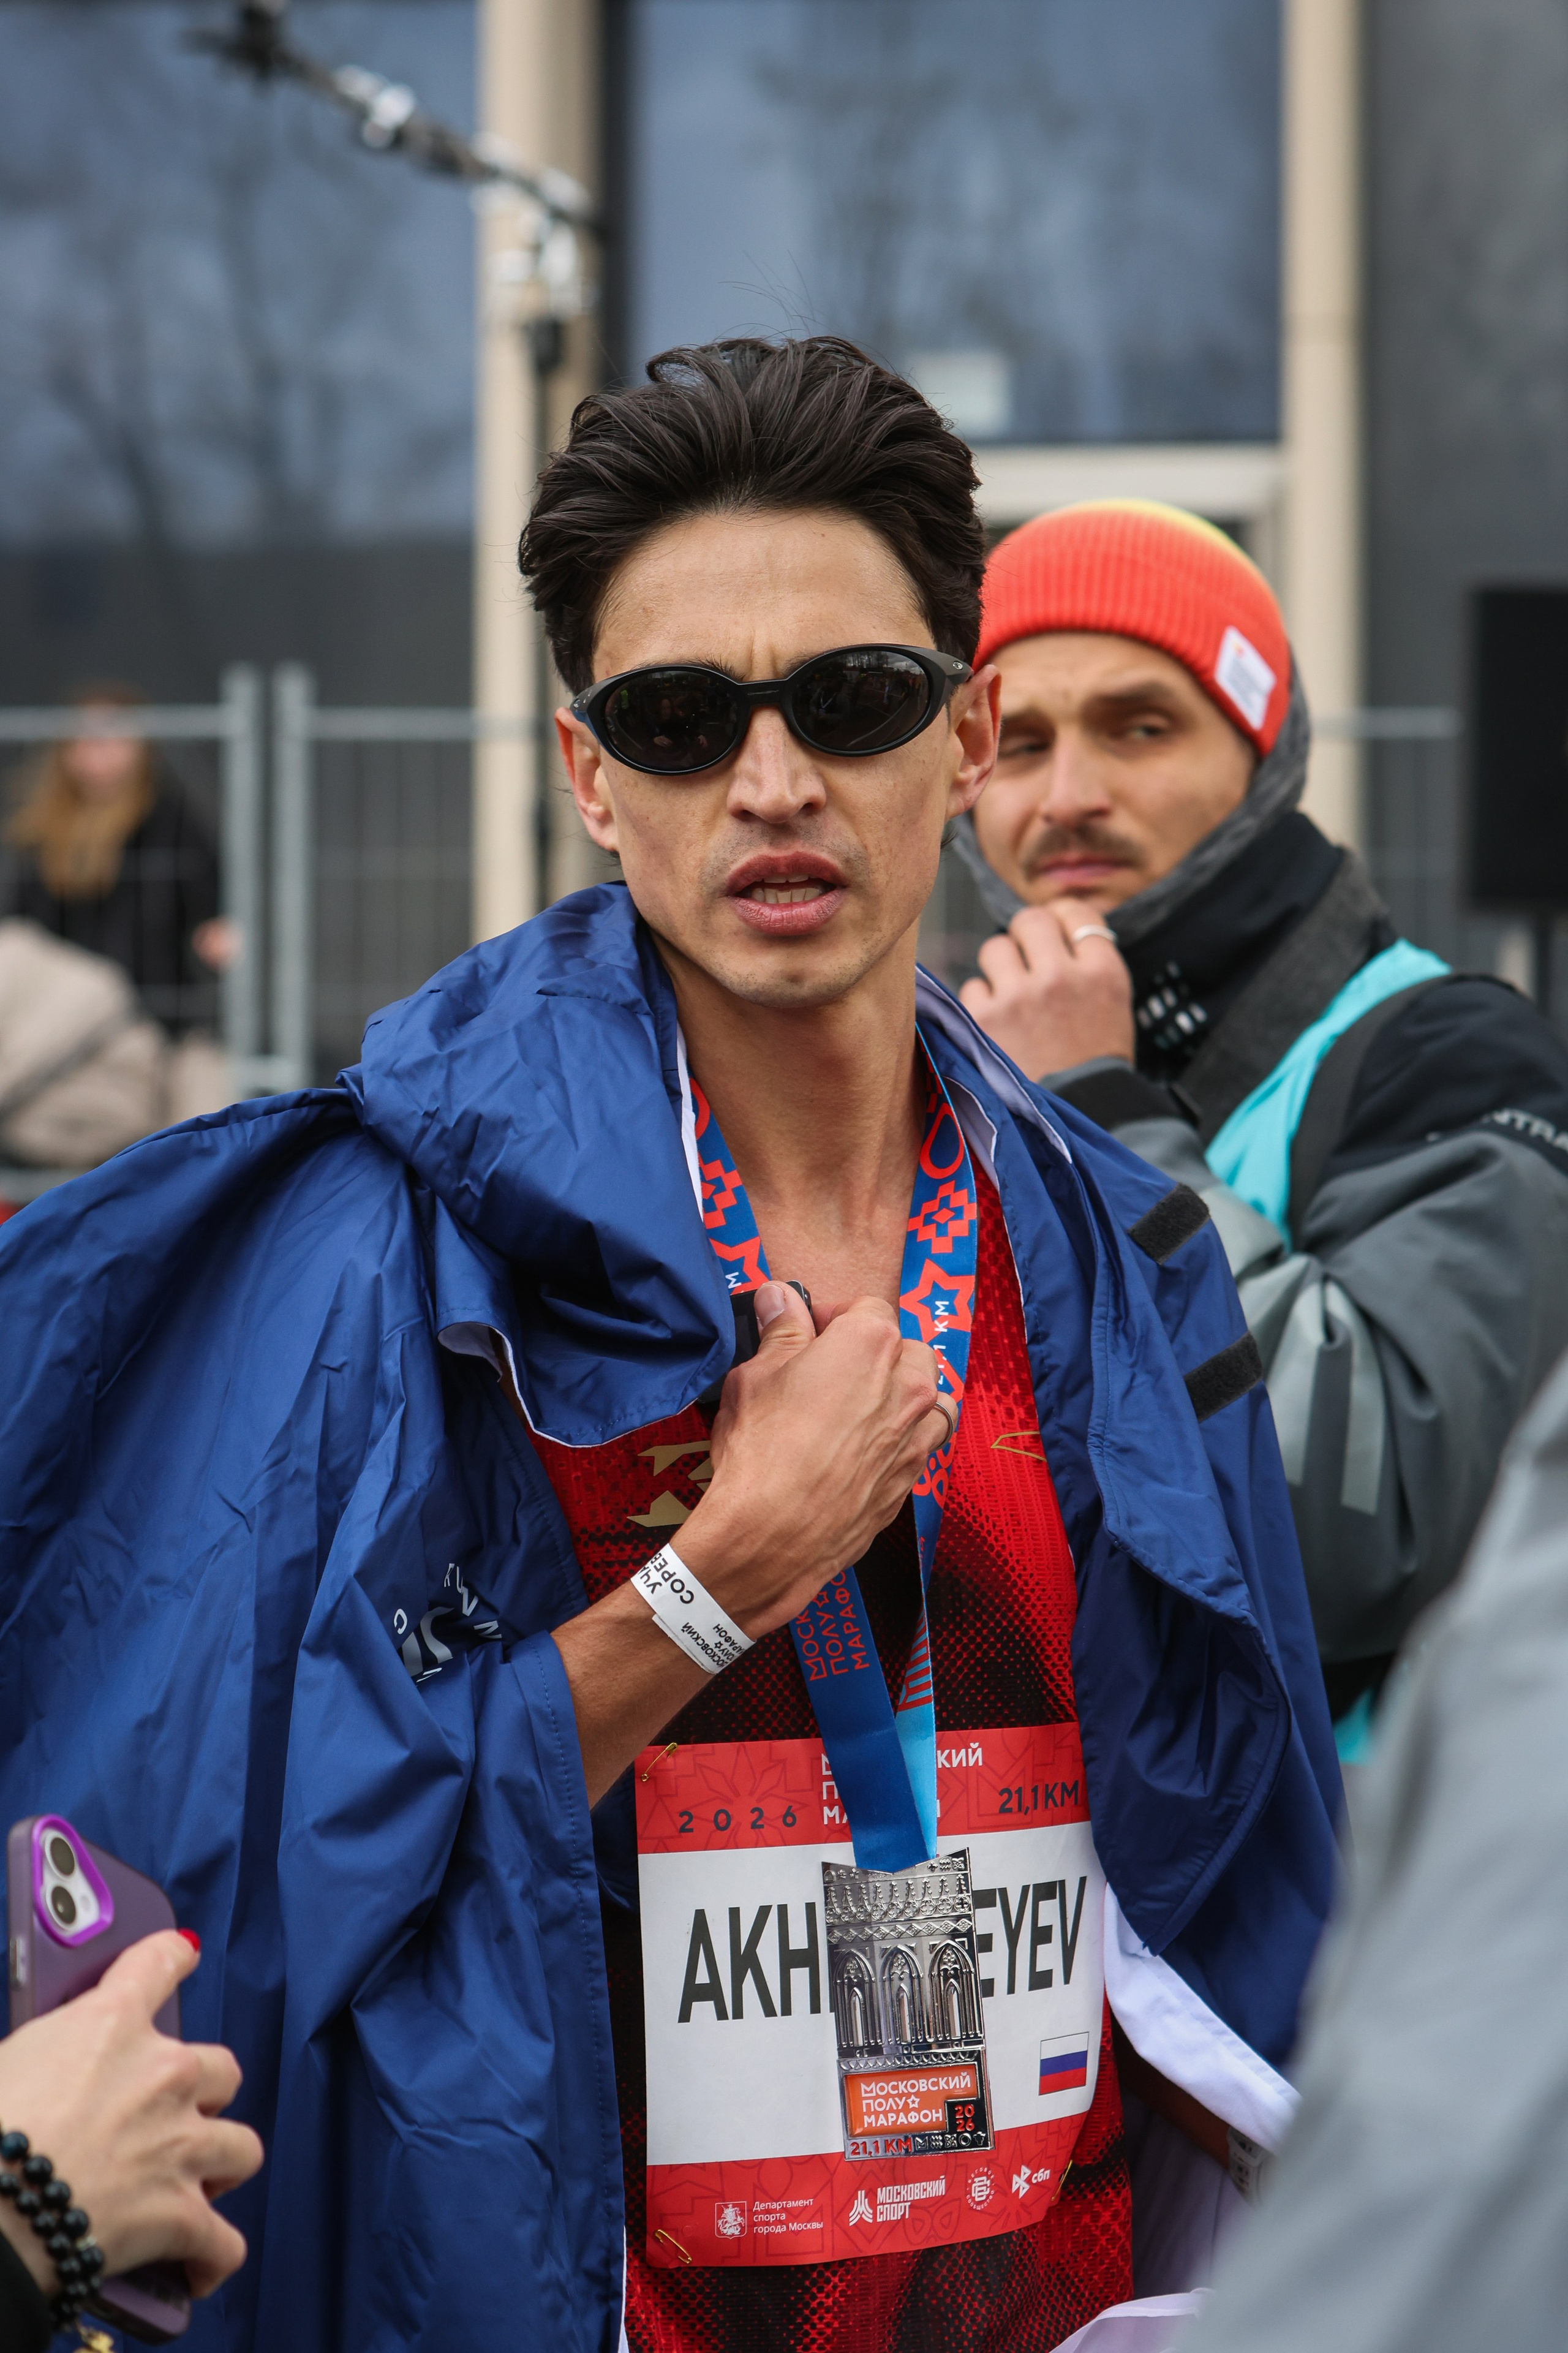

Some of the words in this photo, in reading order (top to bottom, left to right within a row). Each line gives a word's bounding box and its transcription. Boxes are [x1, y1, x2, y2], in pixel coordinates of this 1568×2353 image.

[831, 1571, 870, 1670] МАРАФО
[712, 1623, 745, 1655] АРАФОН
[816, 1611, 849, 1675] ПОЛУ
[861, 2071, 971, 2098] МОСКОВСКИЙ
[862, 2097, 907, 2113] ПОЛУ
[954, 2104, 975, 2119] 20
[864, 2109, 943, 2128] МАРАФОН
[956, 2118, 975, 2132] 26
[877, 2175, 946, 2204] МОСКОВСКИЙ
[753, 2199, 814, 2212] Департамент
[876, 2202, 911, 2223] СПОРТ
[753, 2212, 786, 2224] спорта
[753, 2224, 786, 2236] города
[788, 2221, 823, 2232] Москвы
